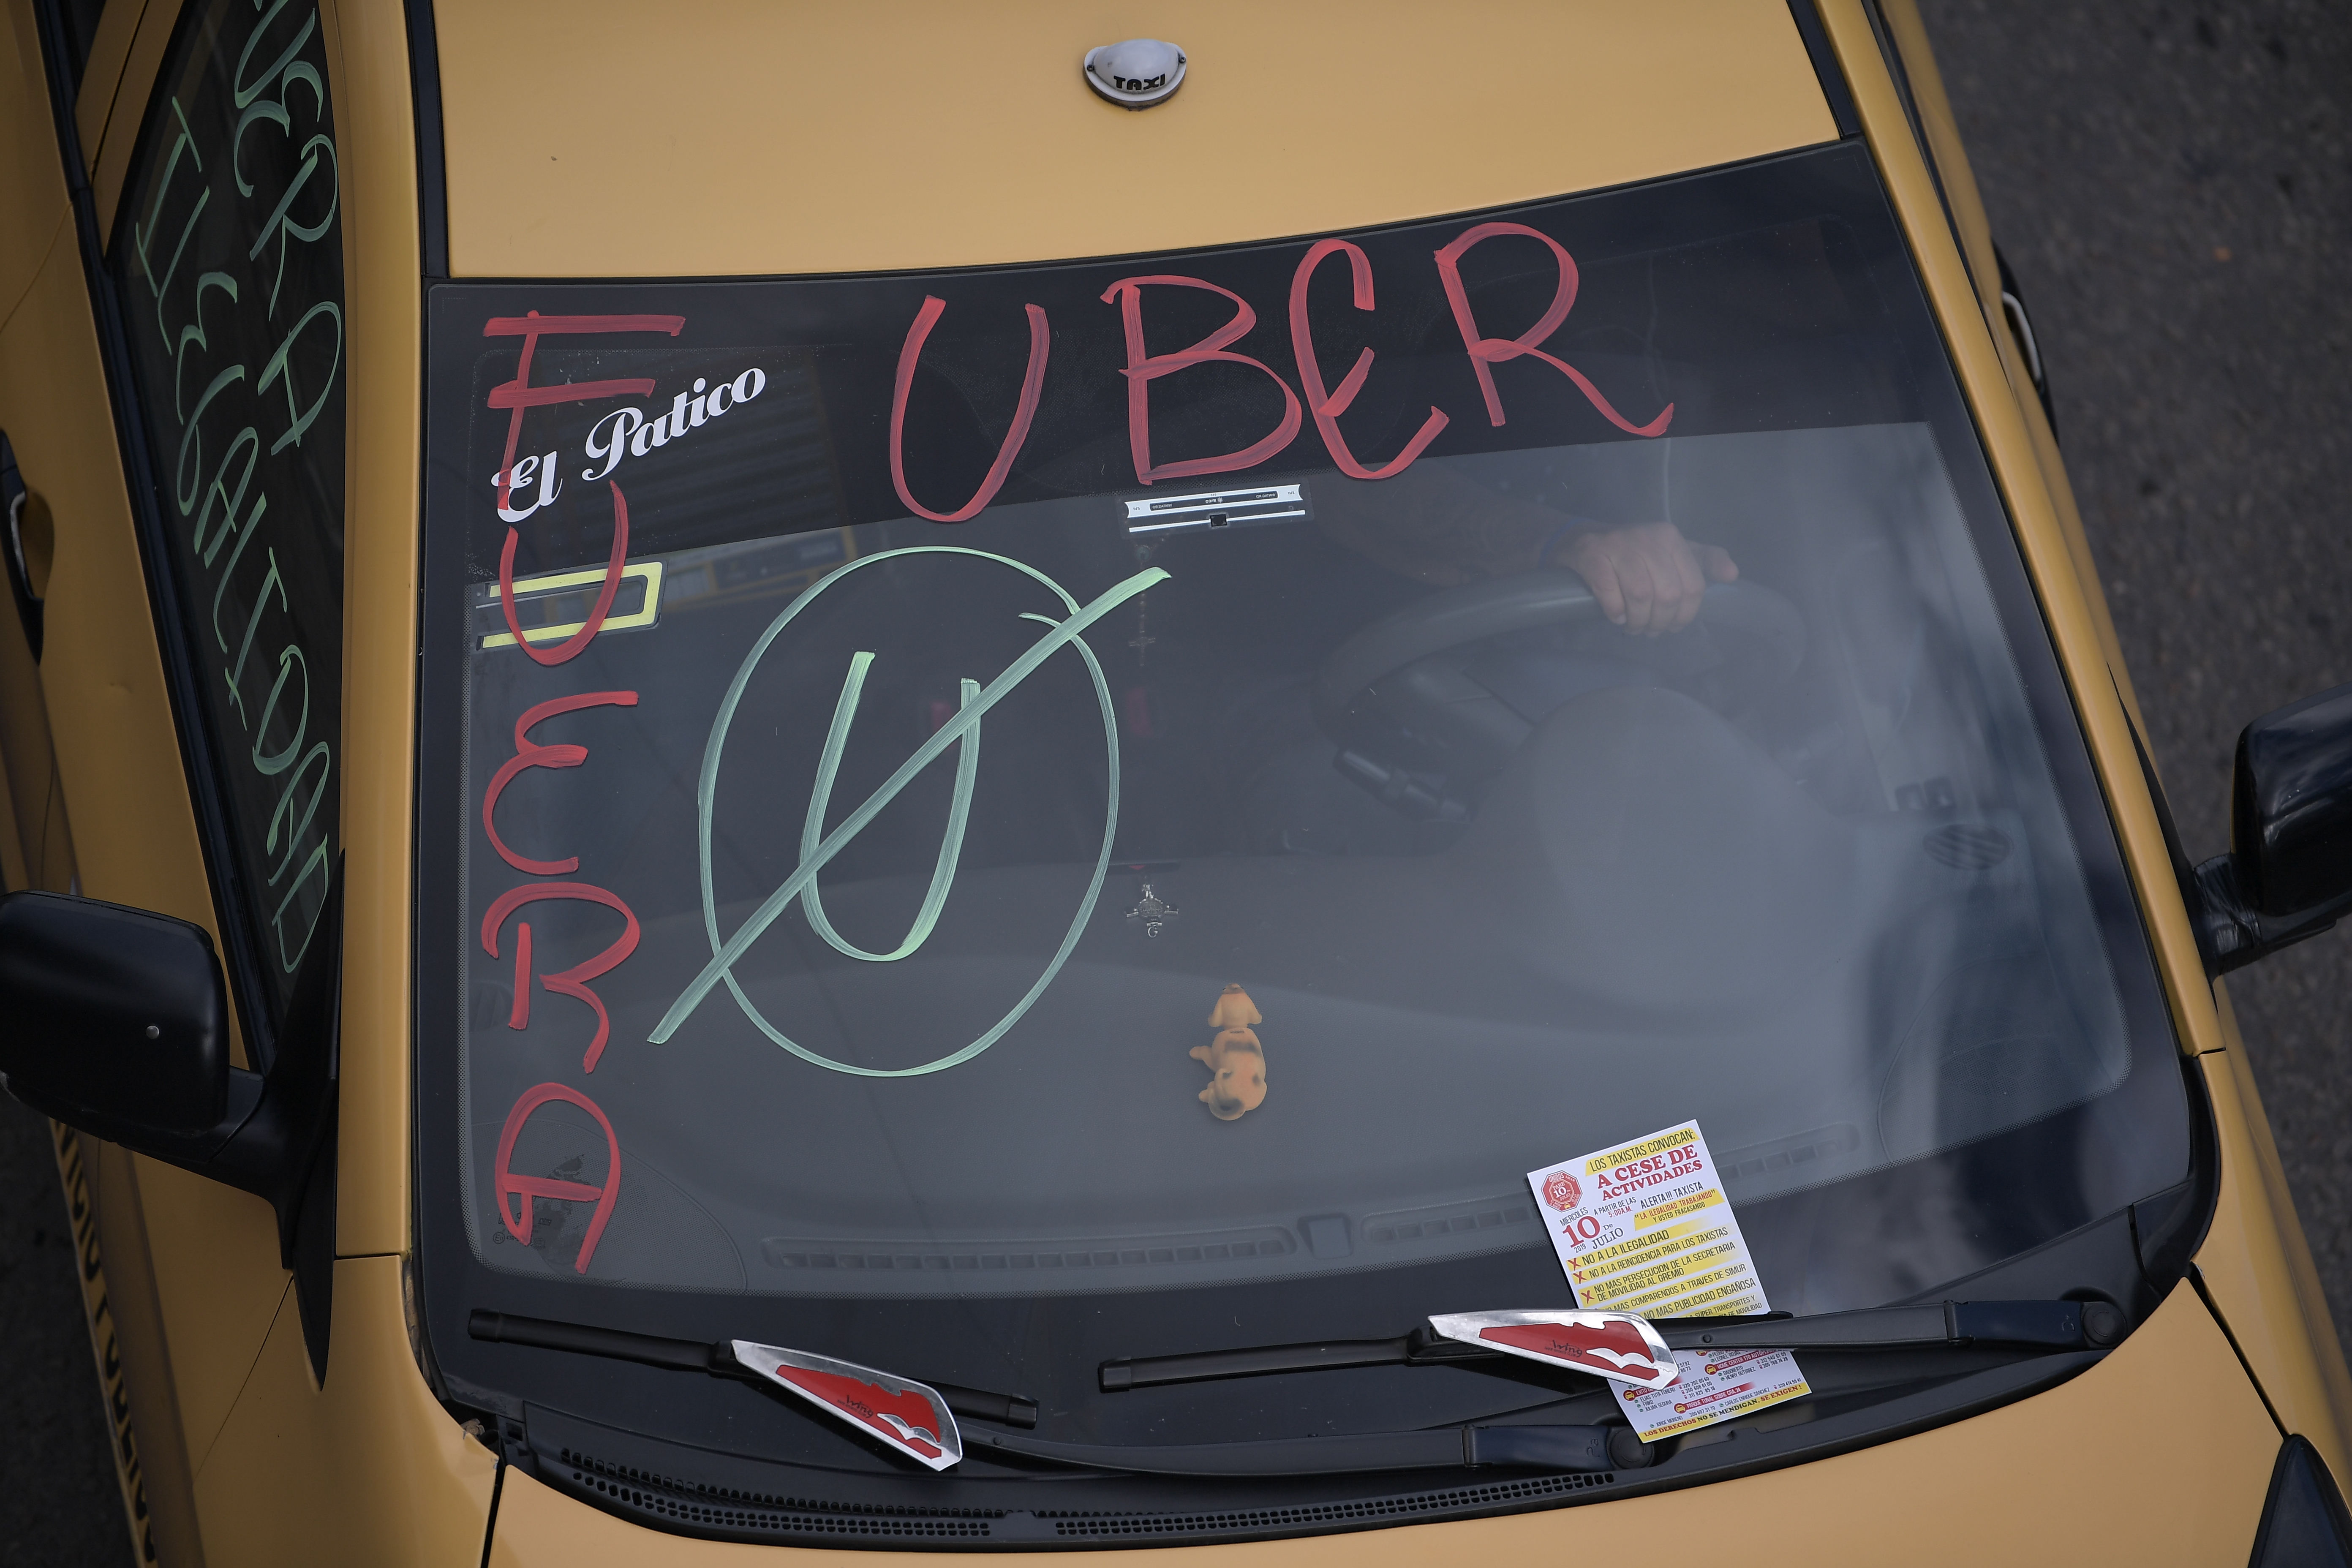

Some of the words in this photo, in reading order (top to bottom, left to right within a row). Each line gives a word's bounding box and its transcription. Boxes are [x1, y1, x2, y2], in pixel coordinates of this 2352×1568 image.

[1113, 73, 1165, 90] TAXI
[234, 0, 341, 456] UERA
[891, 222, 1674, 521] UBER
[490, 450, 564, 523] El
[581, 368, 766, 481] Patico
[482, 310, 686, 1274] FUERA
[1590, 1158, 1606, 1171] LOS
[1607, 1145, 1646, 1165] TAXISTAS
[1647, 1130, 1694, 1152] CONVOCAN:
[1598, 1174, 1612, 1189] A
[1615, 1155, 1665, 1181] CESE
[1667, 1144, 1697, 1165] DE
[1549, 1173, 1564, 1182] UNIDOS
[1552, 1181, 1565, 1190] PARE
[1603, 1160, 1702, 1200] ACTIVIDADES
[1553, 1187, 1566, 1198] 10
[1640, 1191, 1673, 1209] ALERTA!!!
[1673, 1181, 1703, 1197] TAXISTA
[1560, 1207, 1588, 1226] MIERCOLES
[1598, 1203, 1617, 1214] PARTIR
[1617, 1199, 1627, 1207] DE
[1608, 1206, 1632, 1217] 5:00A.M.
[1649, 1202, 1677, 1216] ILEGALIDAD
[1658, 1211, 1673, 1221] USTED
[1674, 1201, 1705, 1215] FRACASANDO
[1563, 1216, 1600, 1247] 10
[1592, 1228, 1623, 1249] JULIO
[1574, 1244, 1586, 1253] 2019
[1582, 1254, 1595, 1265] NO
[1597, 1251, 1604, 1261] A
[1605, 1247, 1618, 1258] LA
[1619, 1230, 1669, 1253] ILEGALIDAD
[1589, 1269, 1599, 1278] NO
[1601, 1266, 1606, 1275] A
[1606, 1263, 1617, 1273] LA
[1617, 1249, 1661, 1269] REINCIDENCIA
[1662, 1242, 1681, 1255] PARA
[1681, 1238, 1695, 1248] LOS
[1696, 1227, 1728, 1243] TAXISTAS
[1594, 1284, 1604, 1293] NO
[1605, 1279, 1622, 1289] MAS
[1622, 1263, 1669, 1284] PERSECUCION
[1670, 1259, 1680, 1269] DE
[1681, 1256, 1692, 1265] LA
[1693, 1242, 1735, 1261] SECRETARIA
[1597, 1292, 1608, 1301] DE
[1608, 1280, 1645, 1297] MOVILIDAD
[1647, 1277, 1657, 1285] AL
[1658, 1268, 1684, 1282] GREMIO
[1614, 1301, 1629, 1312] MAS
[1631, 1286, 1679, 1306] COMPARENDOS
[1687, 1274, 1713, 1288] TRAVES
[1714, 1271, 1724, 1279] DE
[1725, 1264, 1746, 1276] SIMUR
[1643, 1310, 1655, 1320] NO
[1655, 1304, 1673, 1317] MAS
[1674, 1291, 1715, 1311] PUBLICIDAD
[1716, 1278, 1756, 1297] ENGAÑOSA
[1695, 1309, 1712, 1319] SUPER
[1713, 1297, 1750, 1312] TRANSPORTES
[1736, 1302, 1762, 1314] MOVILIDAD
[1723, 1365, 1743, 1375] DAGOBERTO
[1728, 1357, 1743, 1365] CENTER
[1661, 1387, 1675, 1395] FORERO
[1724, 1398, 1739, 1406] CARLOS
[1739, 1393, 1753, 1401] ENRIQUE
[1753, 1387, 1770, 1396] SANCHEZ
[1657, 1399, 1672, 1407] SEGURA
[1658, 1418, 1696, 1432] DERECHOS
[1719, 1399, 1759, 1415] MENDIGAN.
[1770, 1386, 1797, 1398] EXIGEN
[1686, 1400, 1701, 1408] PARQUE
